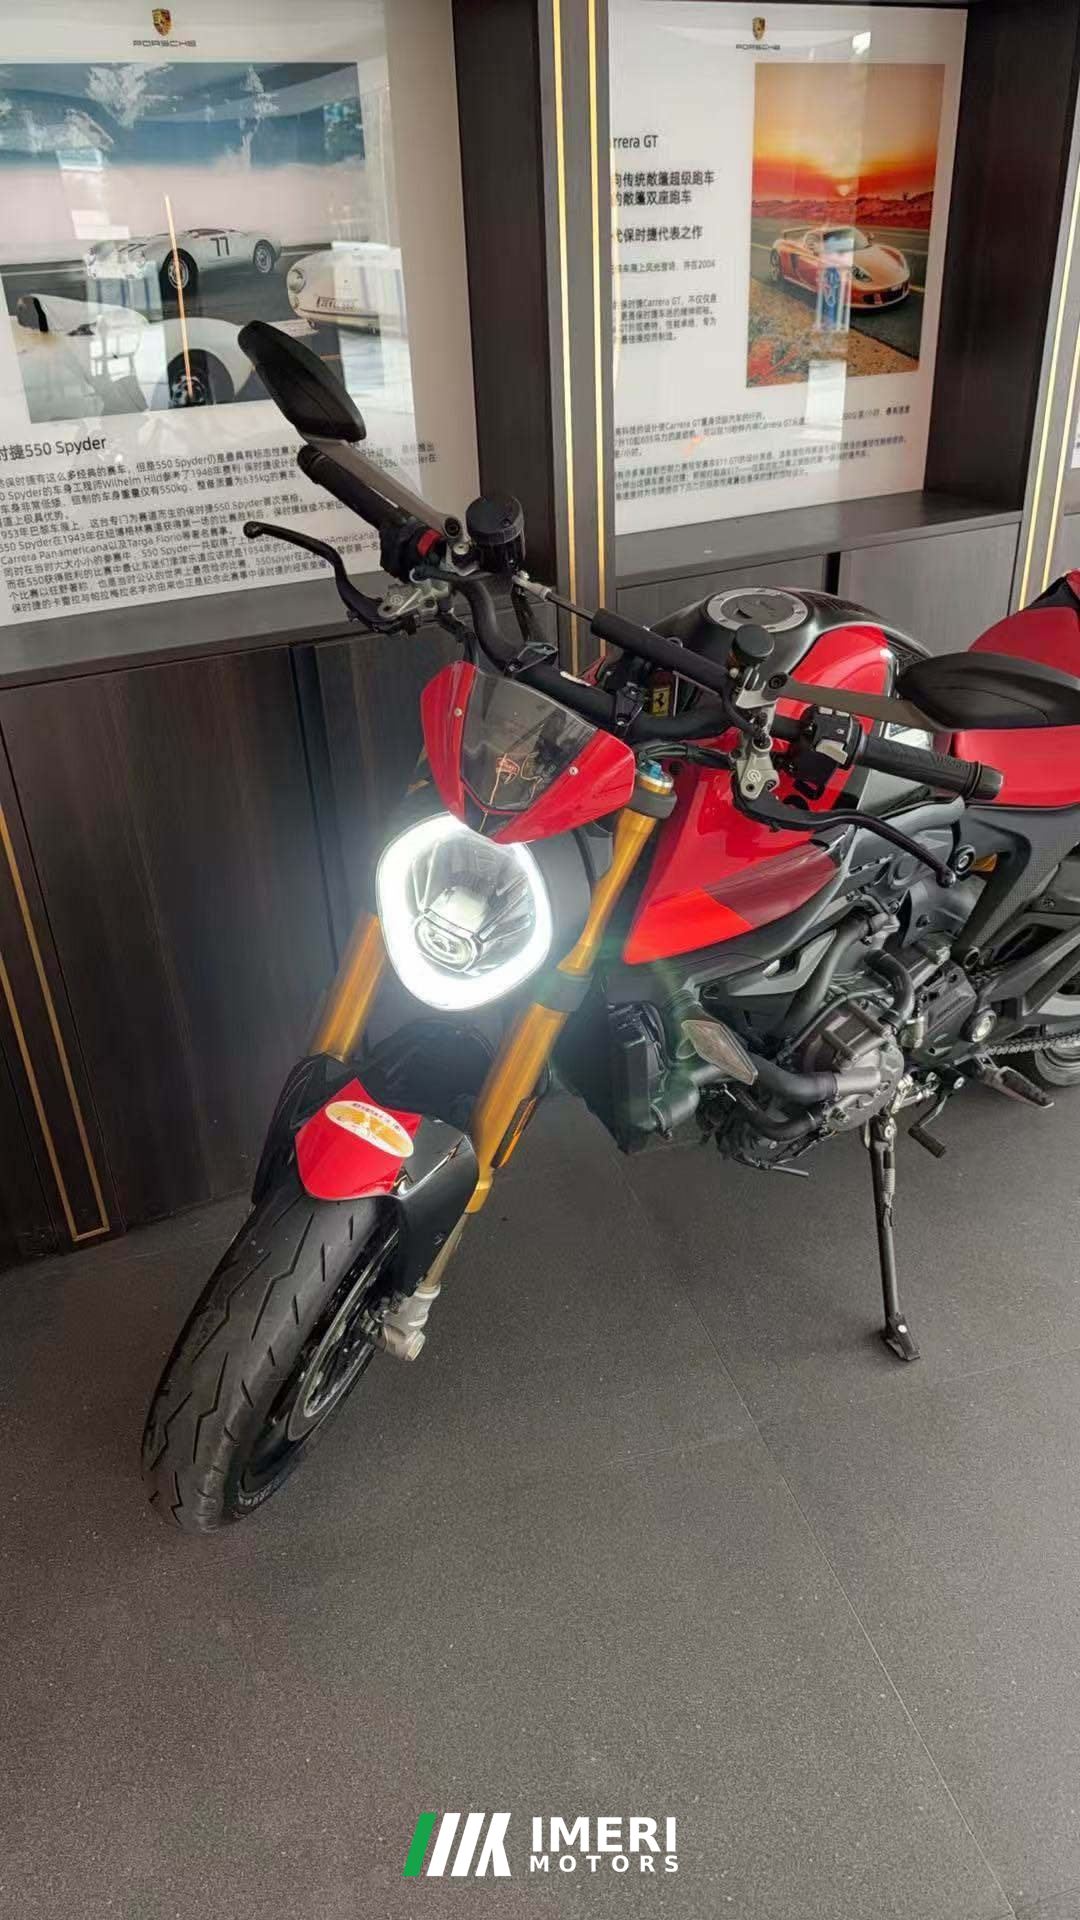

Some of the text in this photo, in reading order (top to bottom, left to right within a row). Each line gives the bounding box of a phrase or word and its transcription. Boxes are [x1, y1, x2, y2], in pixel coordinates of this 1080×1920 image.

[644, 135, 658, 148] GT
[210, 236, 229, 256] 77
[55, 437, 107, 456] Spyder
[1, 553, 36, 565] Carrera
